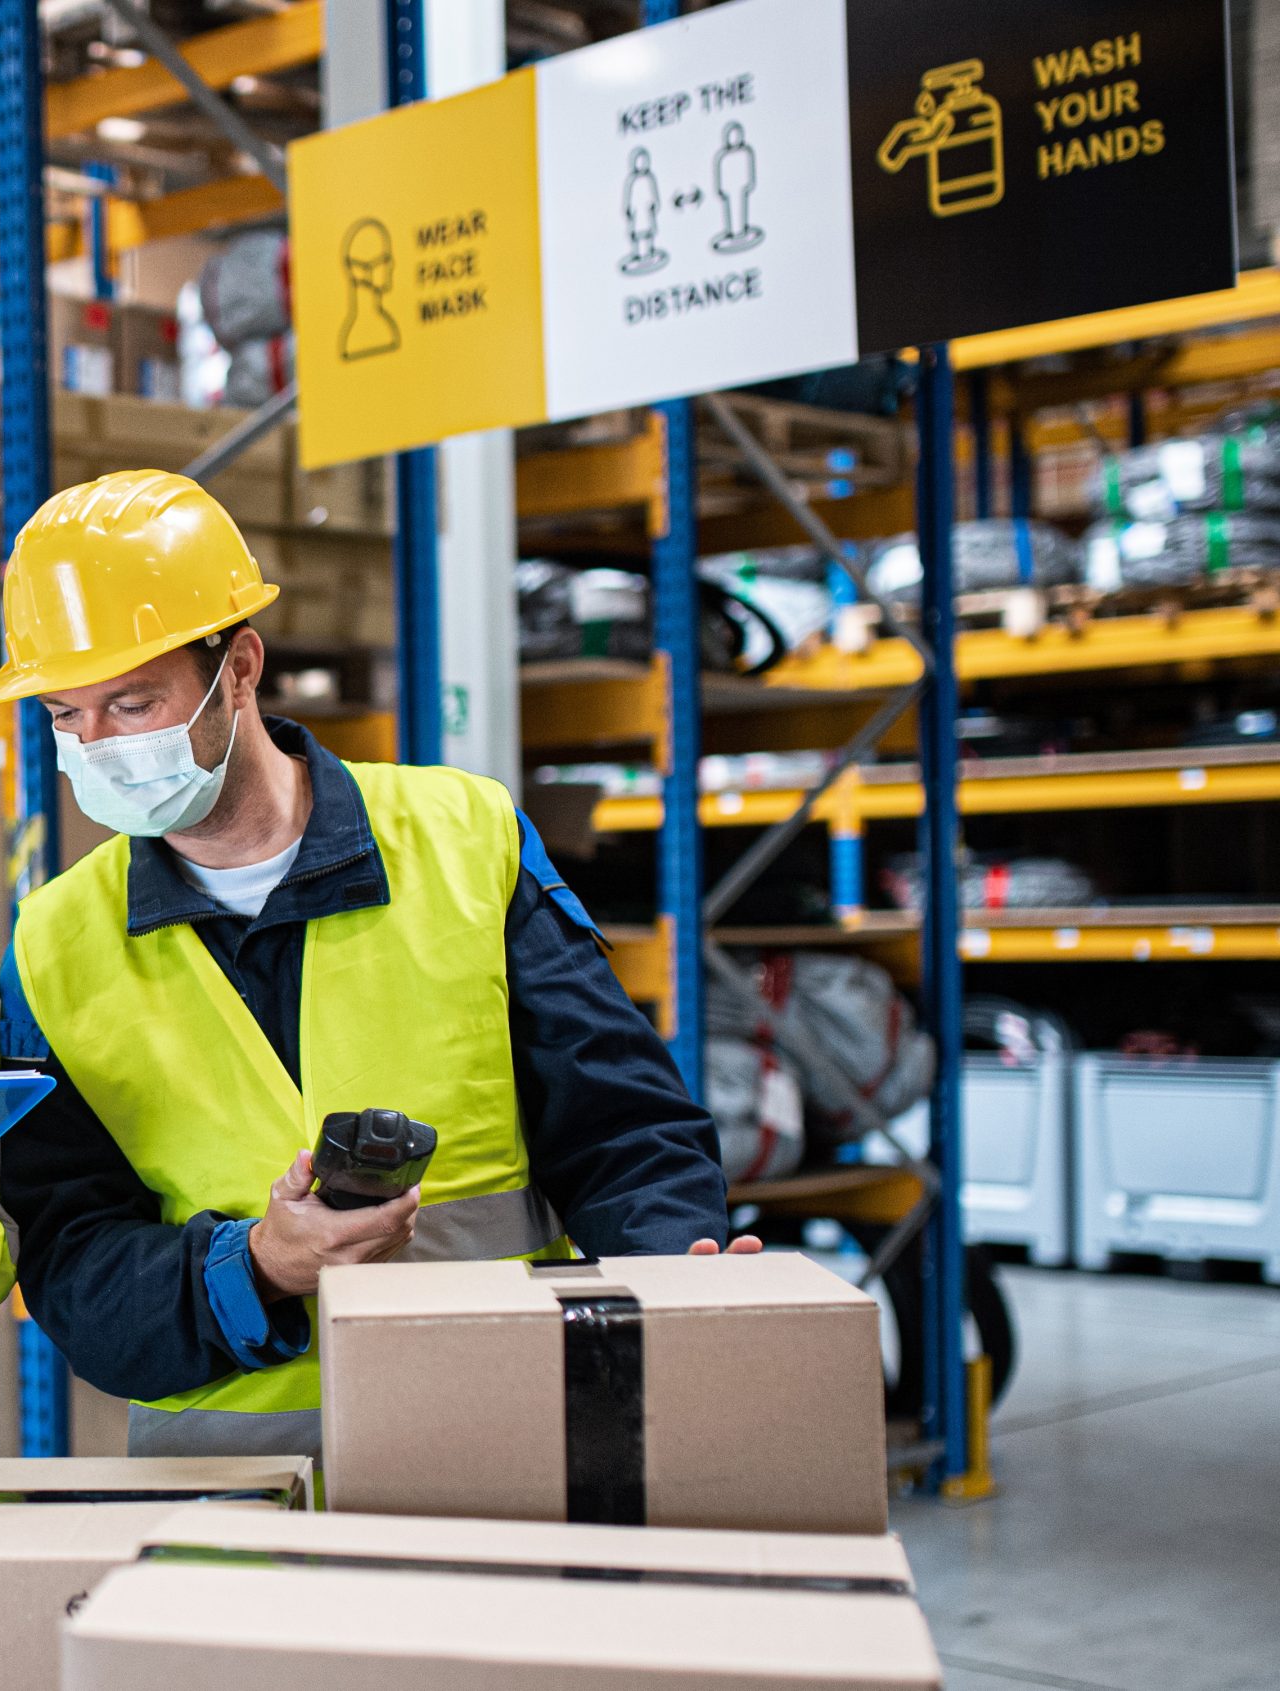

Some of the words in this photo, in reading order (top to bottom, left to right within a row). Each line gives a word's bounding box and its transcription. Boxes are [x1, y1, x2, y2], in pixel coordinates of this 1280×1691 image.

[1032, 31, 1141, 89] WASH
[618, 91, 690, 136] KEEP
[697, 73, 755, 112] THE
[1034, 79, 1140, 133] YOUR
[1037, 119, 1165, 180] HANDS
[417, 210, 486, 248] WEAR
[417, 250, 478, 286] FACE
[419, 286, 487, 322] MASK
[625, 268, 762, 324] DISTANCE
